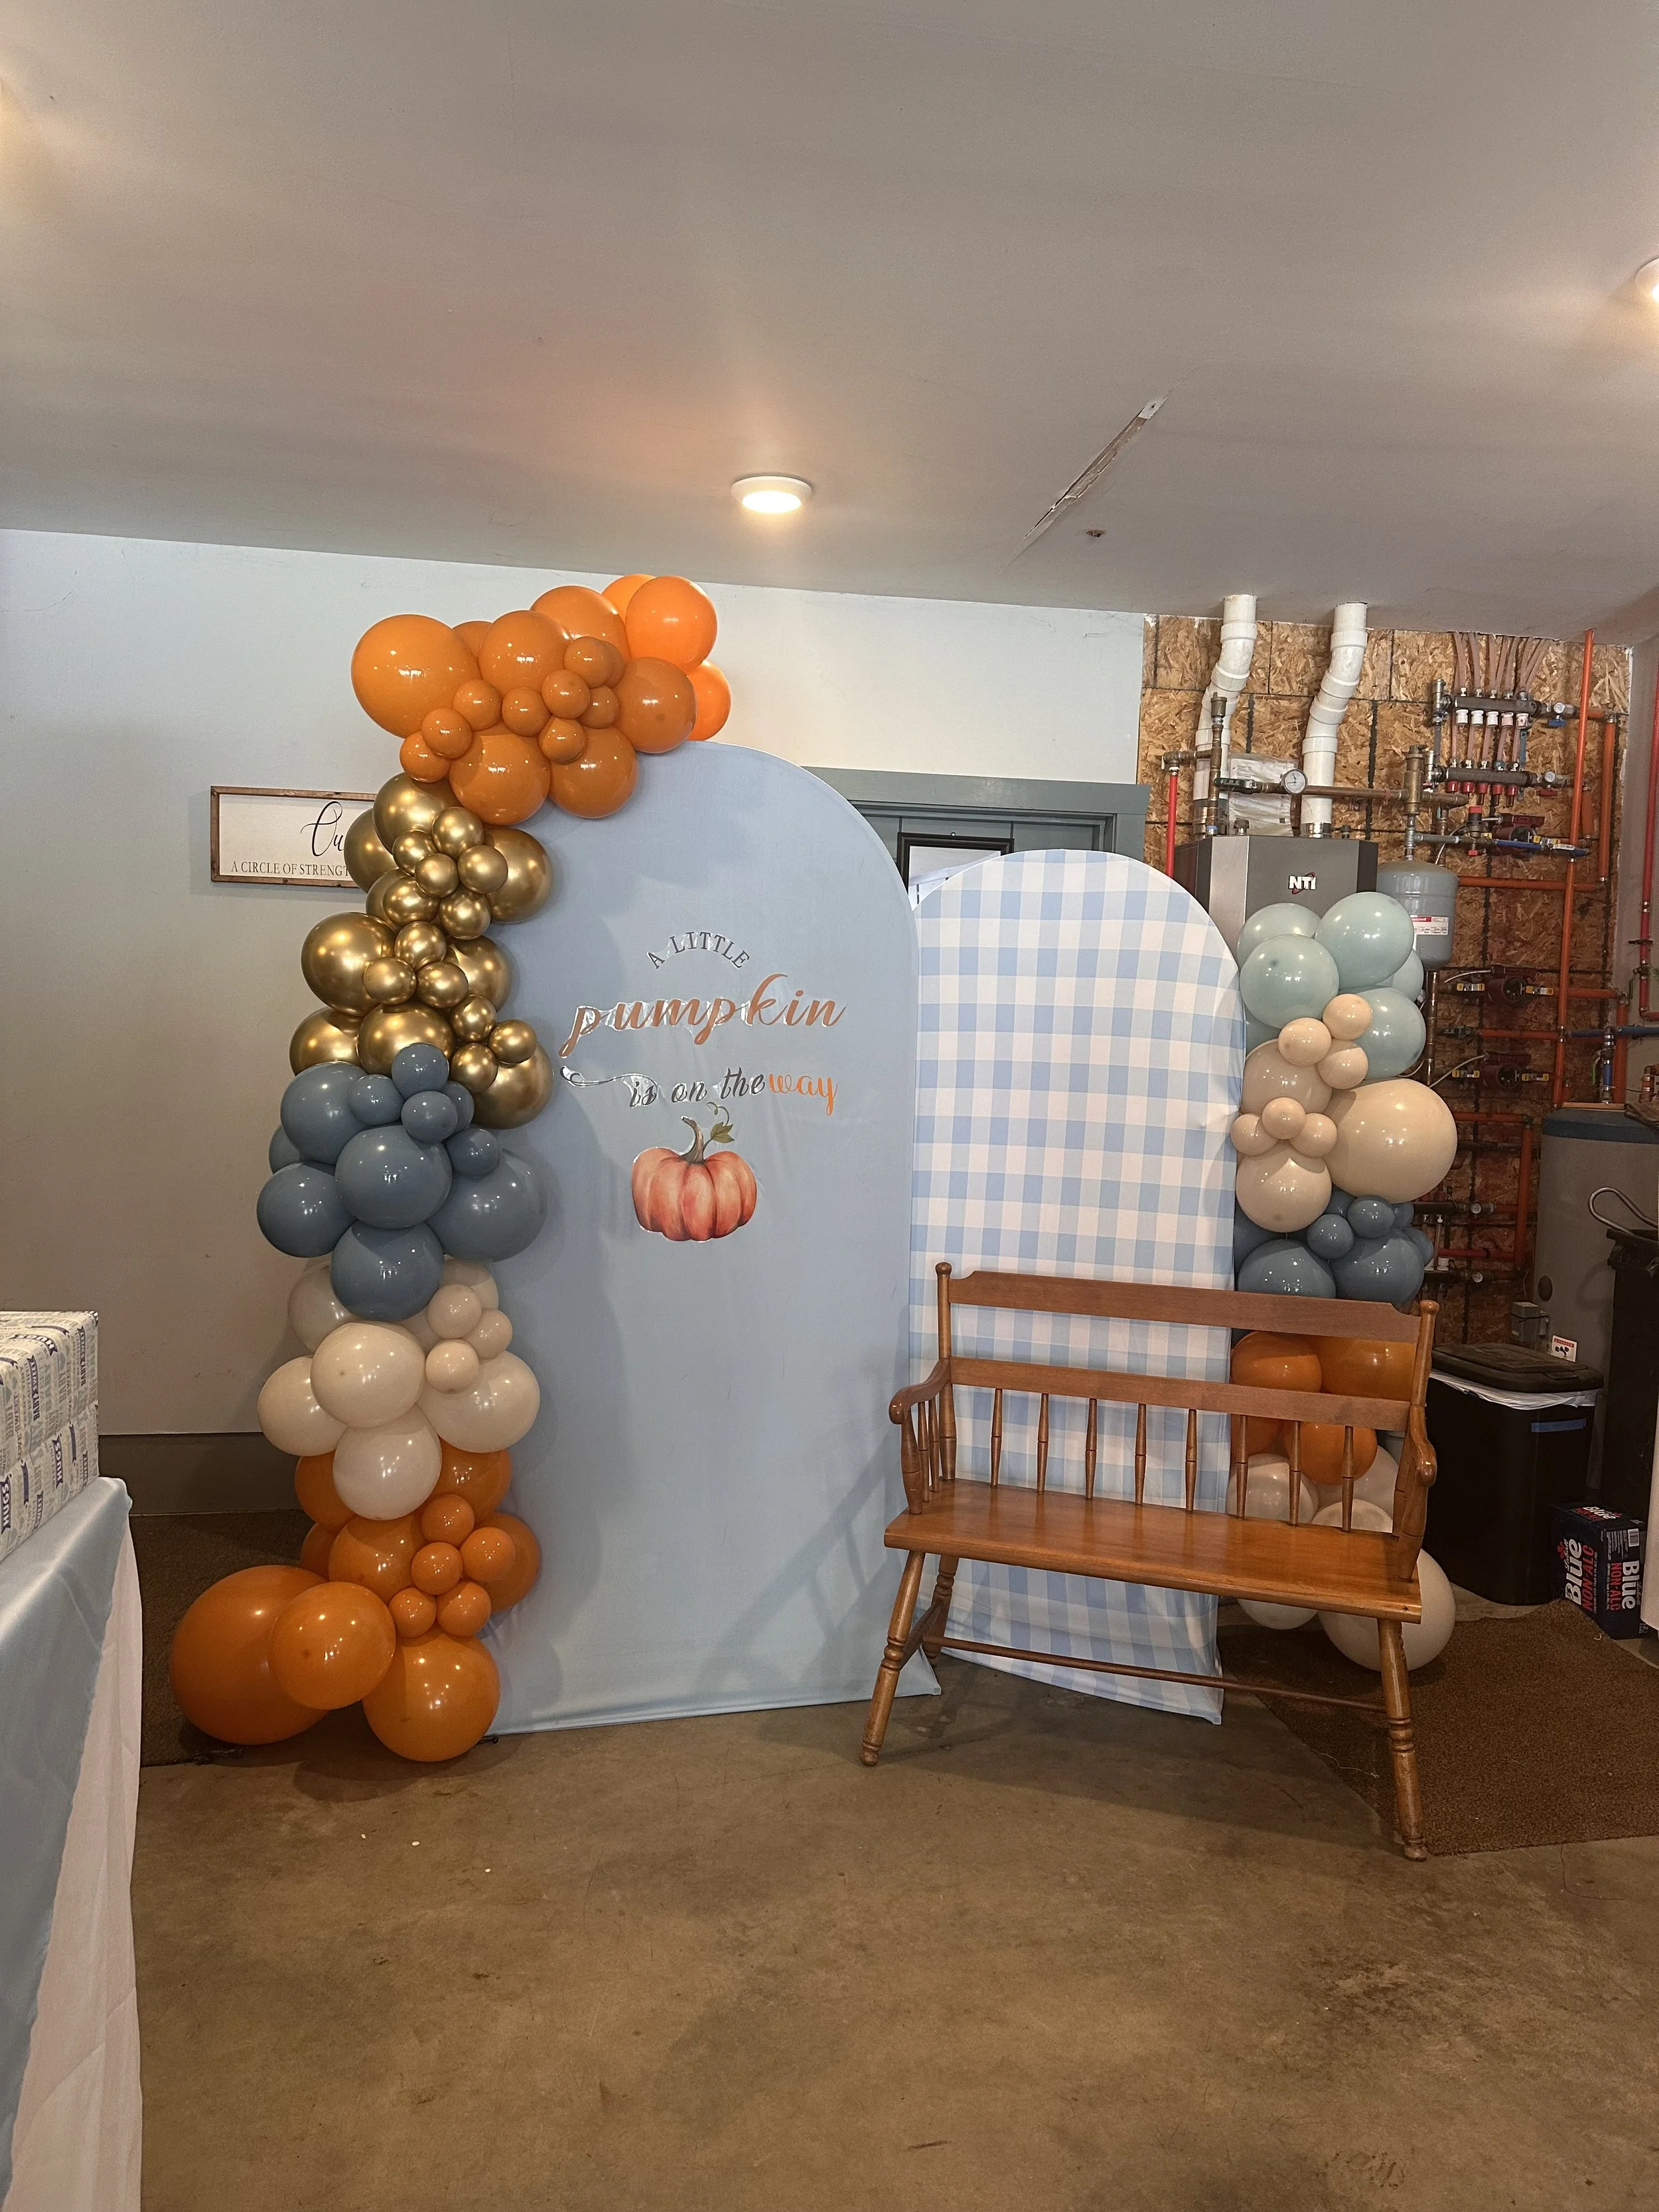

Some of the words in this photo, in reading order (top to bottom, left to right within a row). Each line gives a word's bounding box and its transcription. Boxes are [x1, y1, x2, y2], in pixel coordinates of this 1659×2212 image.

[301, 801, 344, 856] Ou
[231, 861, 238, 872] A
[241, 861, 280, 873] CIRCLE
[283, 863, 297, 874] OF
[299, 863, 348, 876] STRENGT
[1289, 875, 1317, 890] NTI
[648, 952, 665, 969] A
[670, 931, 750, 968] LITTLE
[558, 973, 847, 1058] pumpkin
[671, 1081, 707, 1103] on
[720, 1067, 765, 1099] the
[768, 1072, 838, 1116] way
[1565, 1538, 1583, 1605] Blue
[1610, 1562, 1623, 1611] NON-ALC
[1622, 1560, 1640, 1609] Blue
